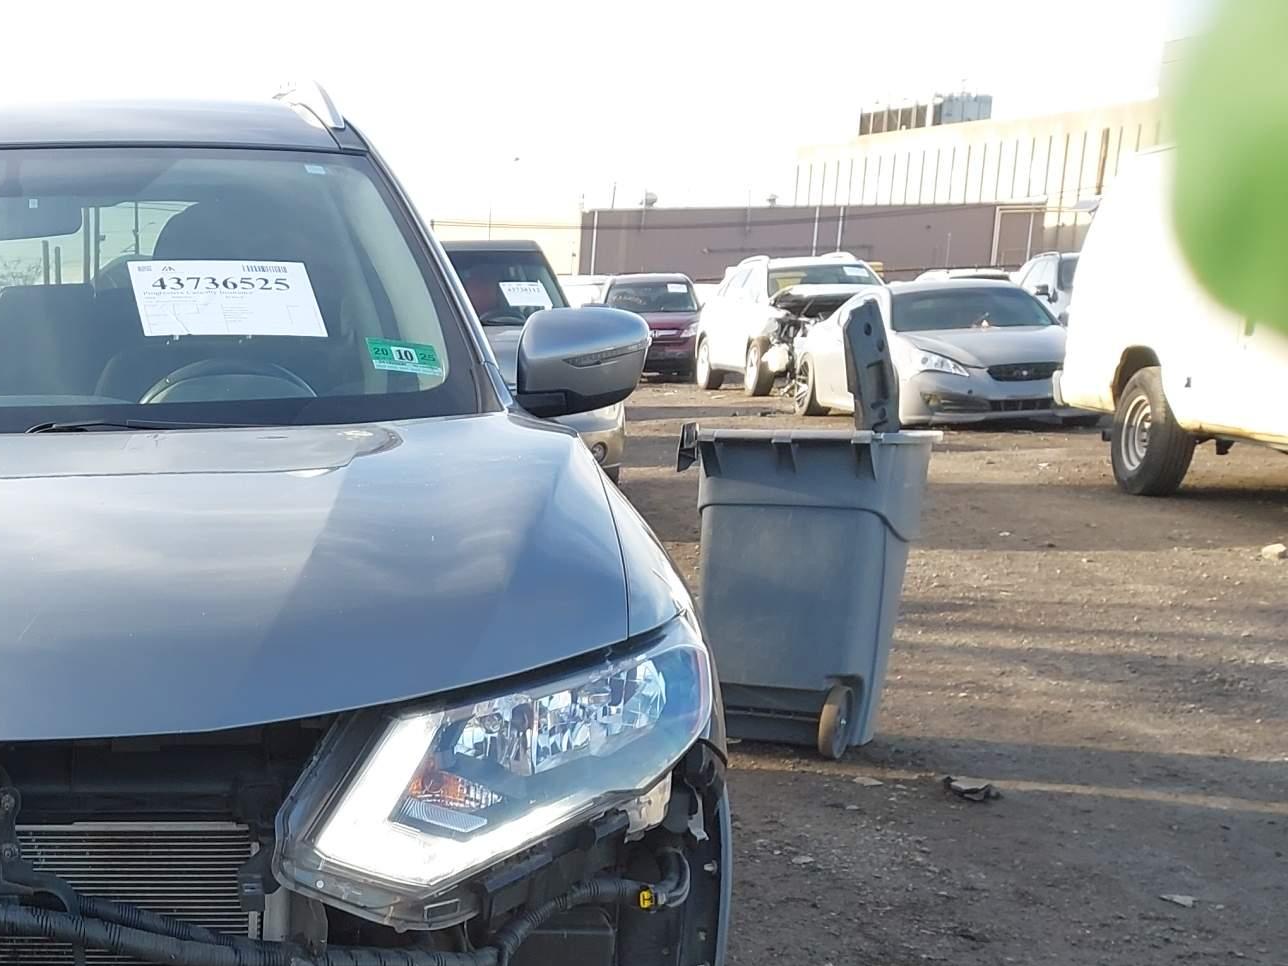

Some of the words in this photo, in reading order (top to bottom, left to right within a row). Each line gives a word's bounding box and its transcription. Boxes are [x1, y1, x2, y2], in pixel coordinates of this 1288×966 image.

[152, 277, 290, 291] 43736525
[373, 347, 389, 356] 20
[395, 349, 414, 361] 10
[419, 352, 436, 361] 25
